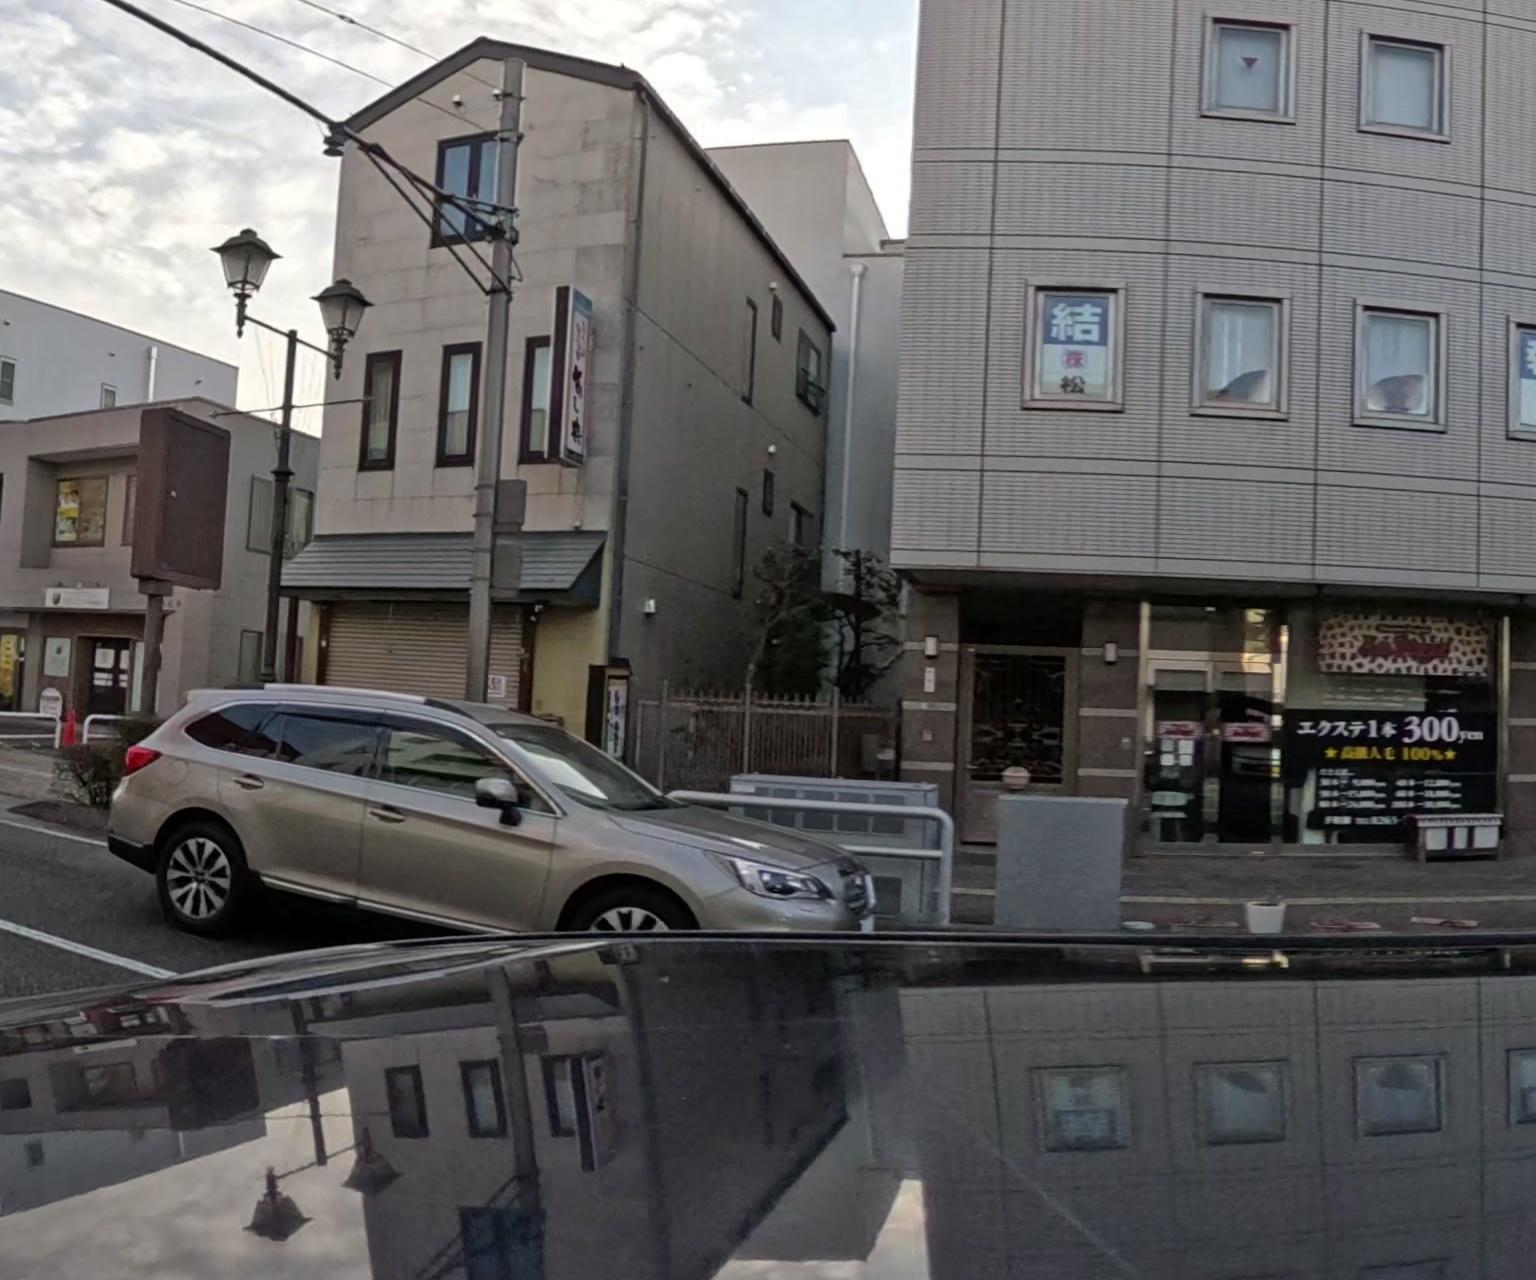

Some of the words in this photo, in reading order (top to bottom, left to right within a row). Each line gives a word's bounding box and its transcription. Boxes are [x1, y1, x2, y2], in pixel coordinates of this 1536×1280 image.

[1050, 303, 1102, 342] 結
[1060, 376, 1086, 394] 松
[1296, 719, 1397, 738] エクステ1本
[1402, 715, 1484, 744] 300yen
